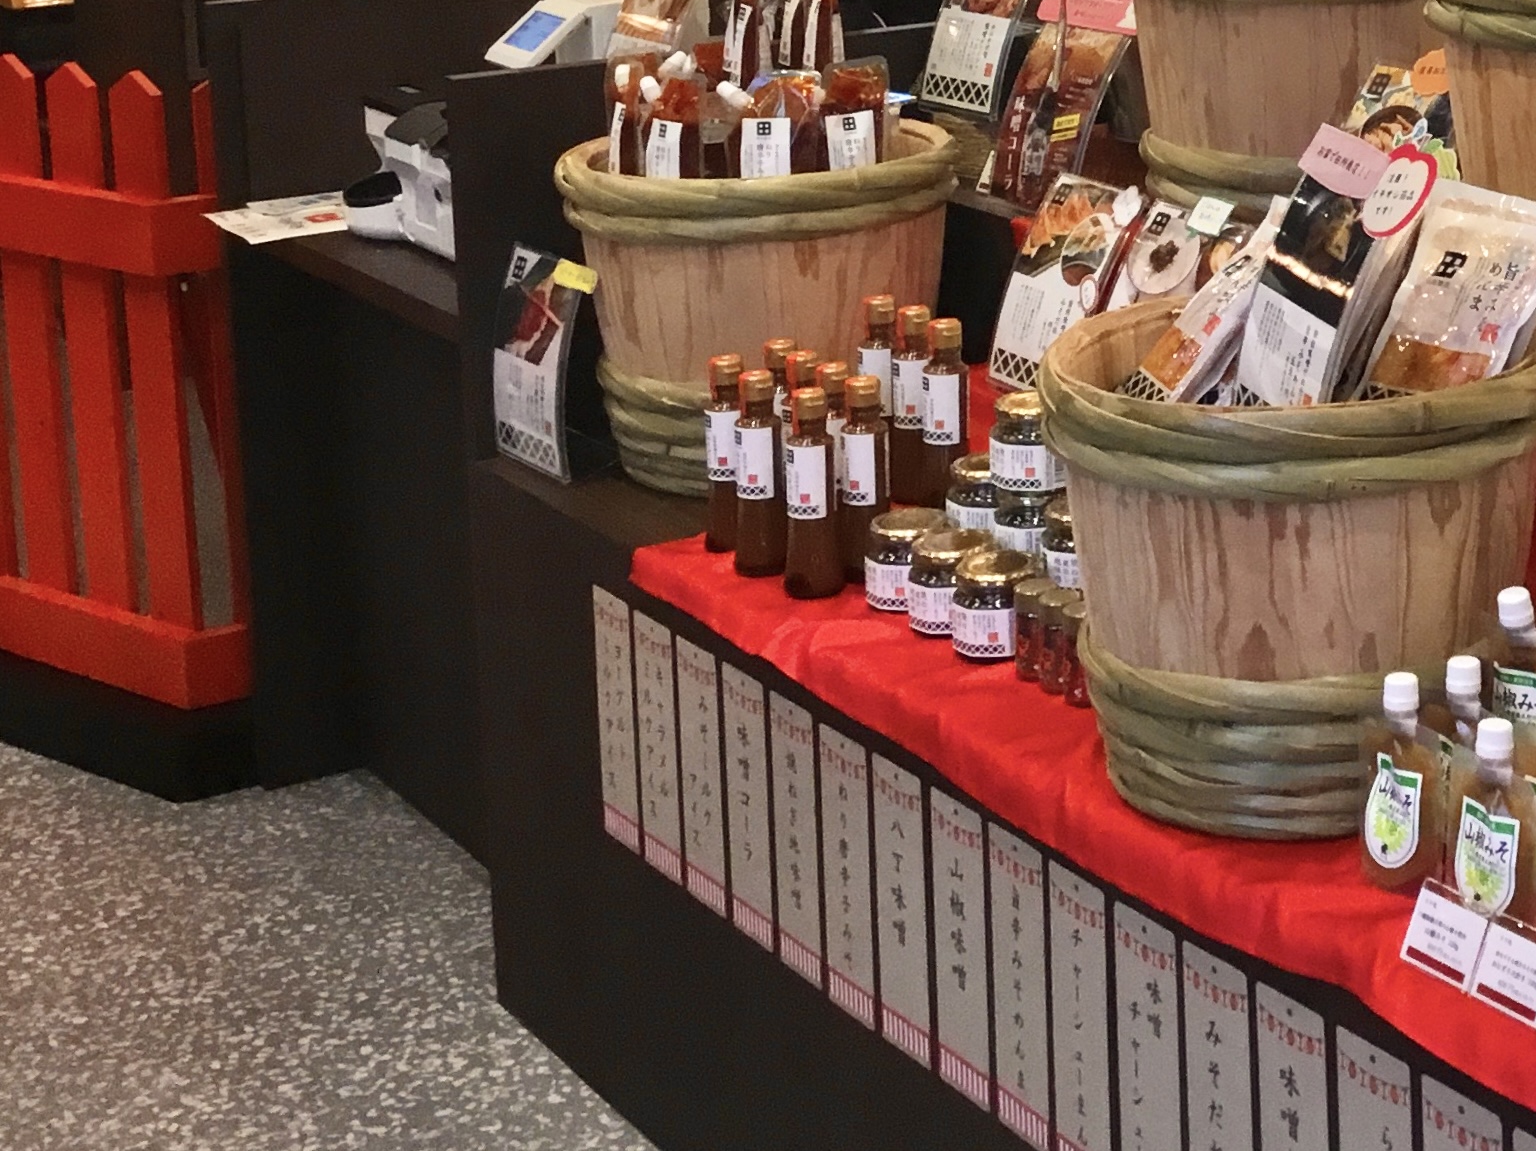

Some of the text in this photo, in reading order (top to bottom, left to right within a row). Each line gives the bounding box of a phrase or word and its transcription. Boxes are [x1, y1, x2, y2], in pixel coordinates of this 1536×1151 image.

[737, 722, 753, 862] 味噌コーラ
[891, 820, 907, 948] 八丁味噌
[949, 857, 967, 992] 山椒味噌
[1071, 928, 1088, 1146] チャーシューまん
[1146, 978, 1162, 1040] 味噌
